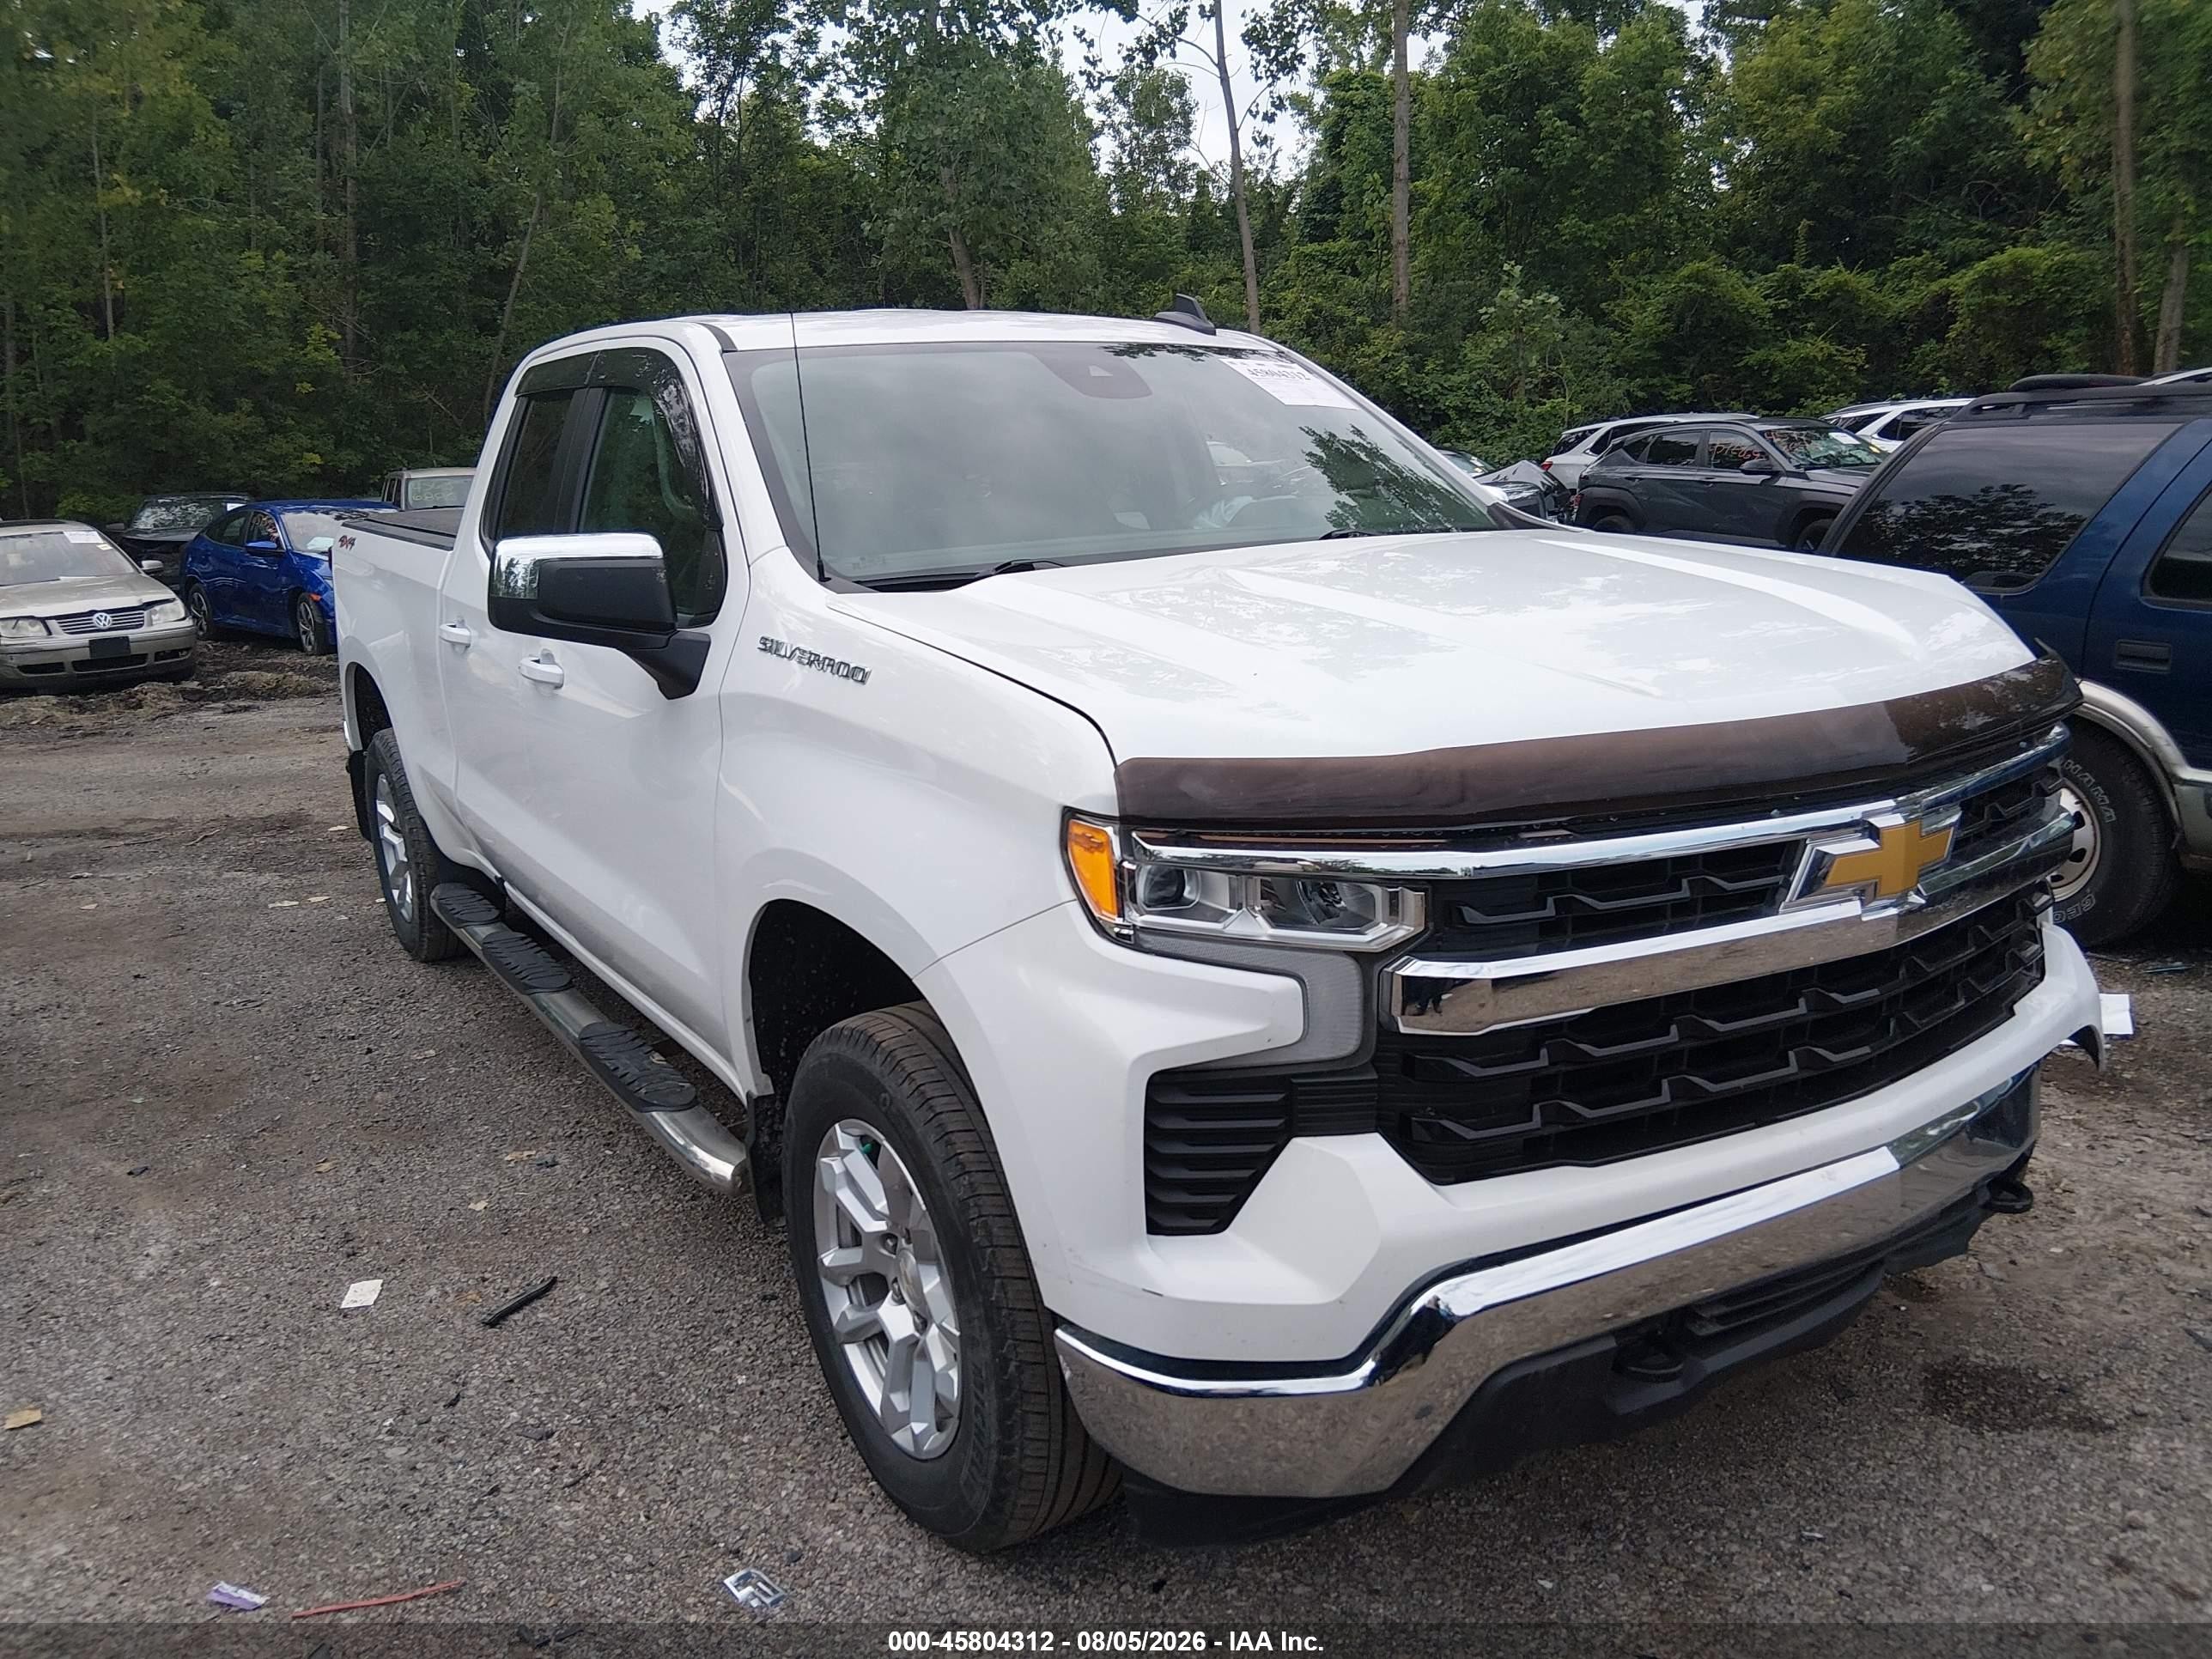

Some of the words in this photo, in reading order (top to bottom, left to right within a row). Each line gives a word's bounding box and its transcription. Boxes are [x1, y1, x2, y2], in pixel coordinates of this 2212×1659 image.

[94, 613, 112, 629] VW
[757, 635, 872, 685] SILVERADO
[2052, 892, 2096, 924] GEO
